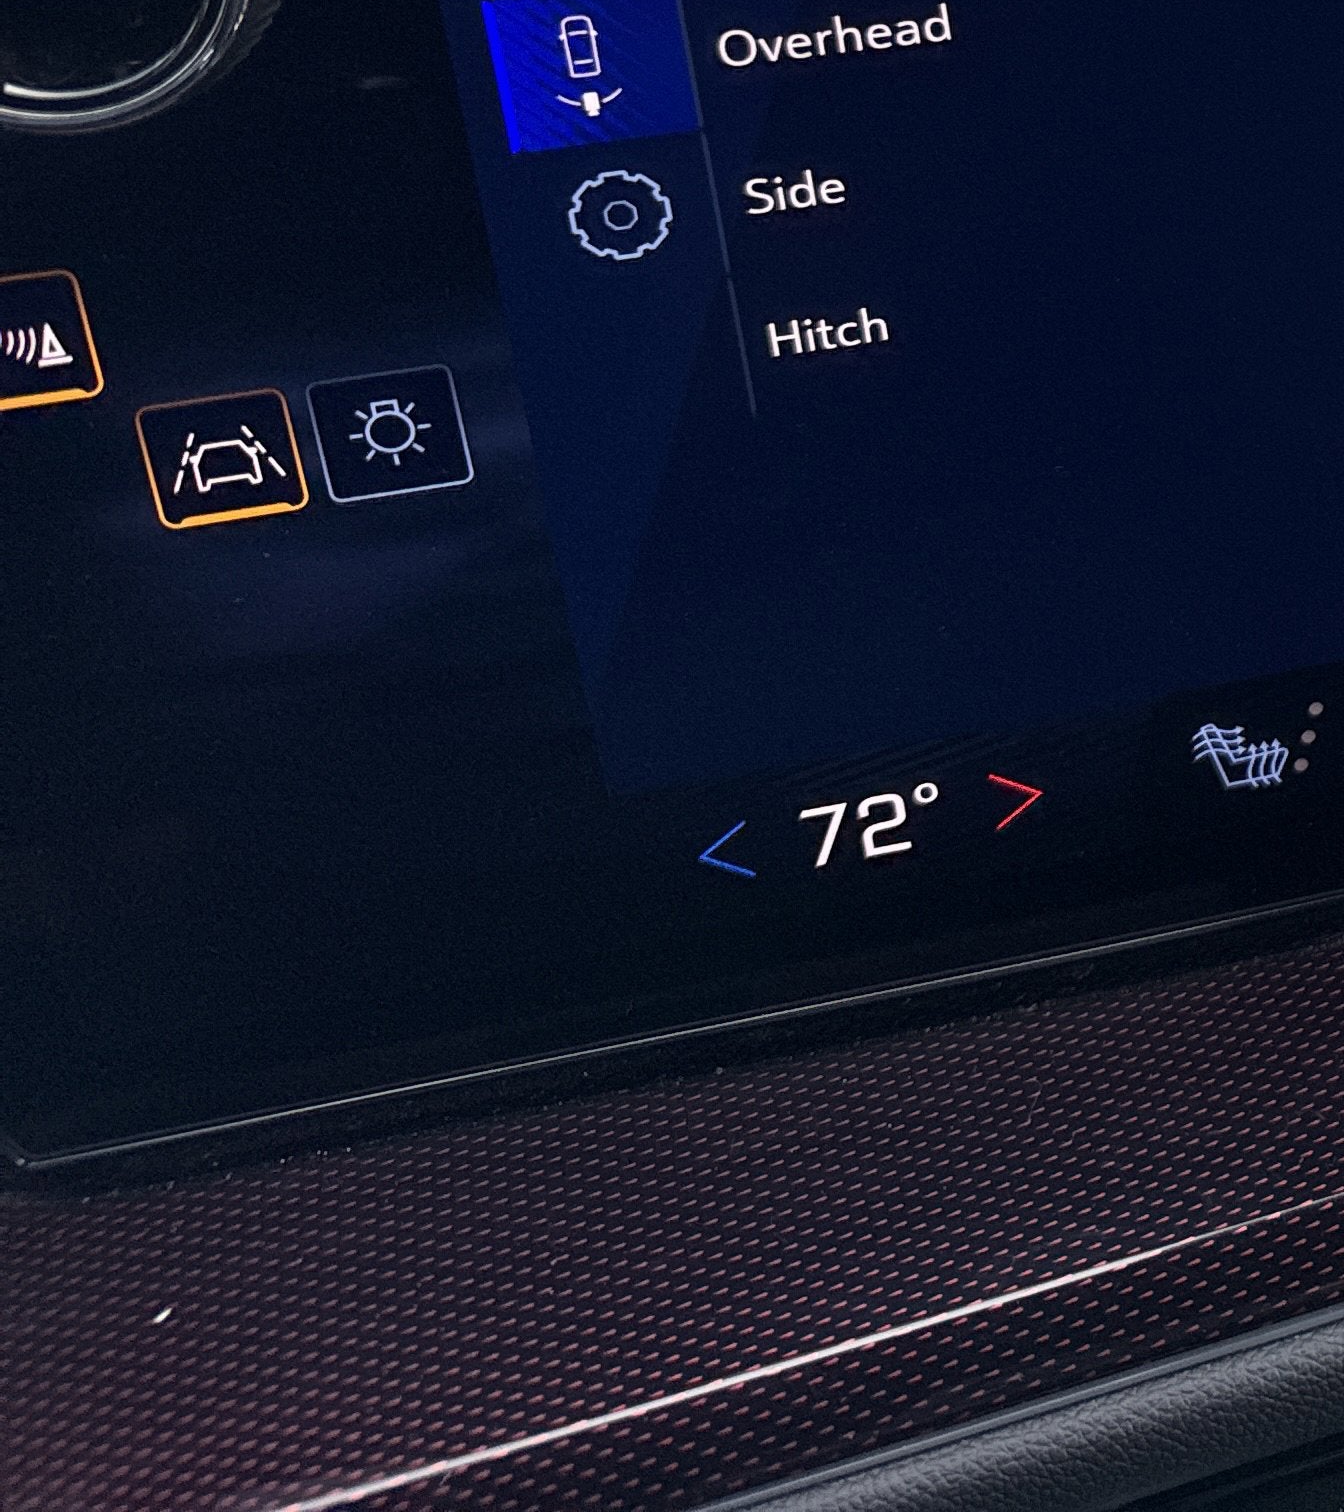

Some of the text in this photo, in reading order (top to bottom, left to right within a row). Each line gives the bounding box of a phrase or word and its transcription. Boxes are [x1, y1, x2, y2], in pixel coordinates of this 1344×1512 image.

[716, 1, 953, 68] Overhead
[743, 167, 847, 216] Side
[766, 306, 890, 358] Hitch
[798, 781, 940, 869] 72°
